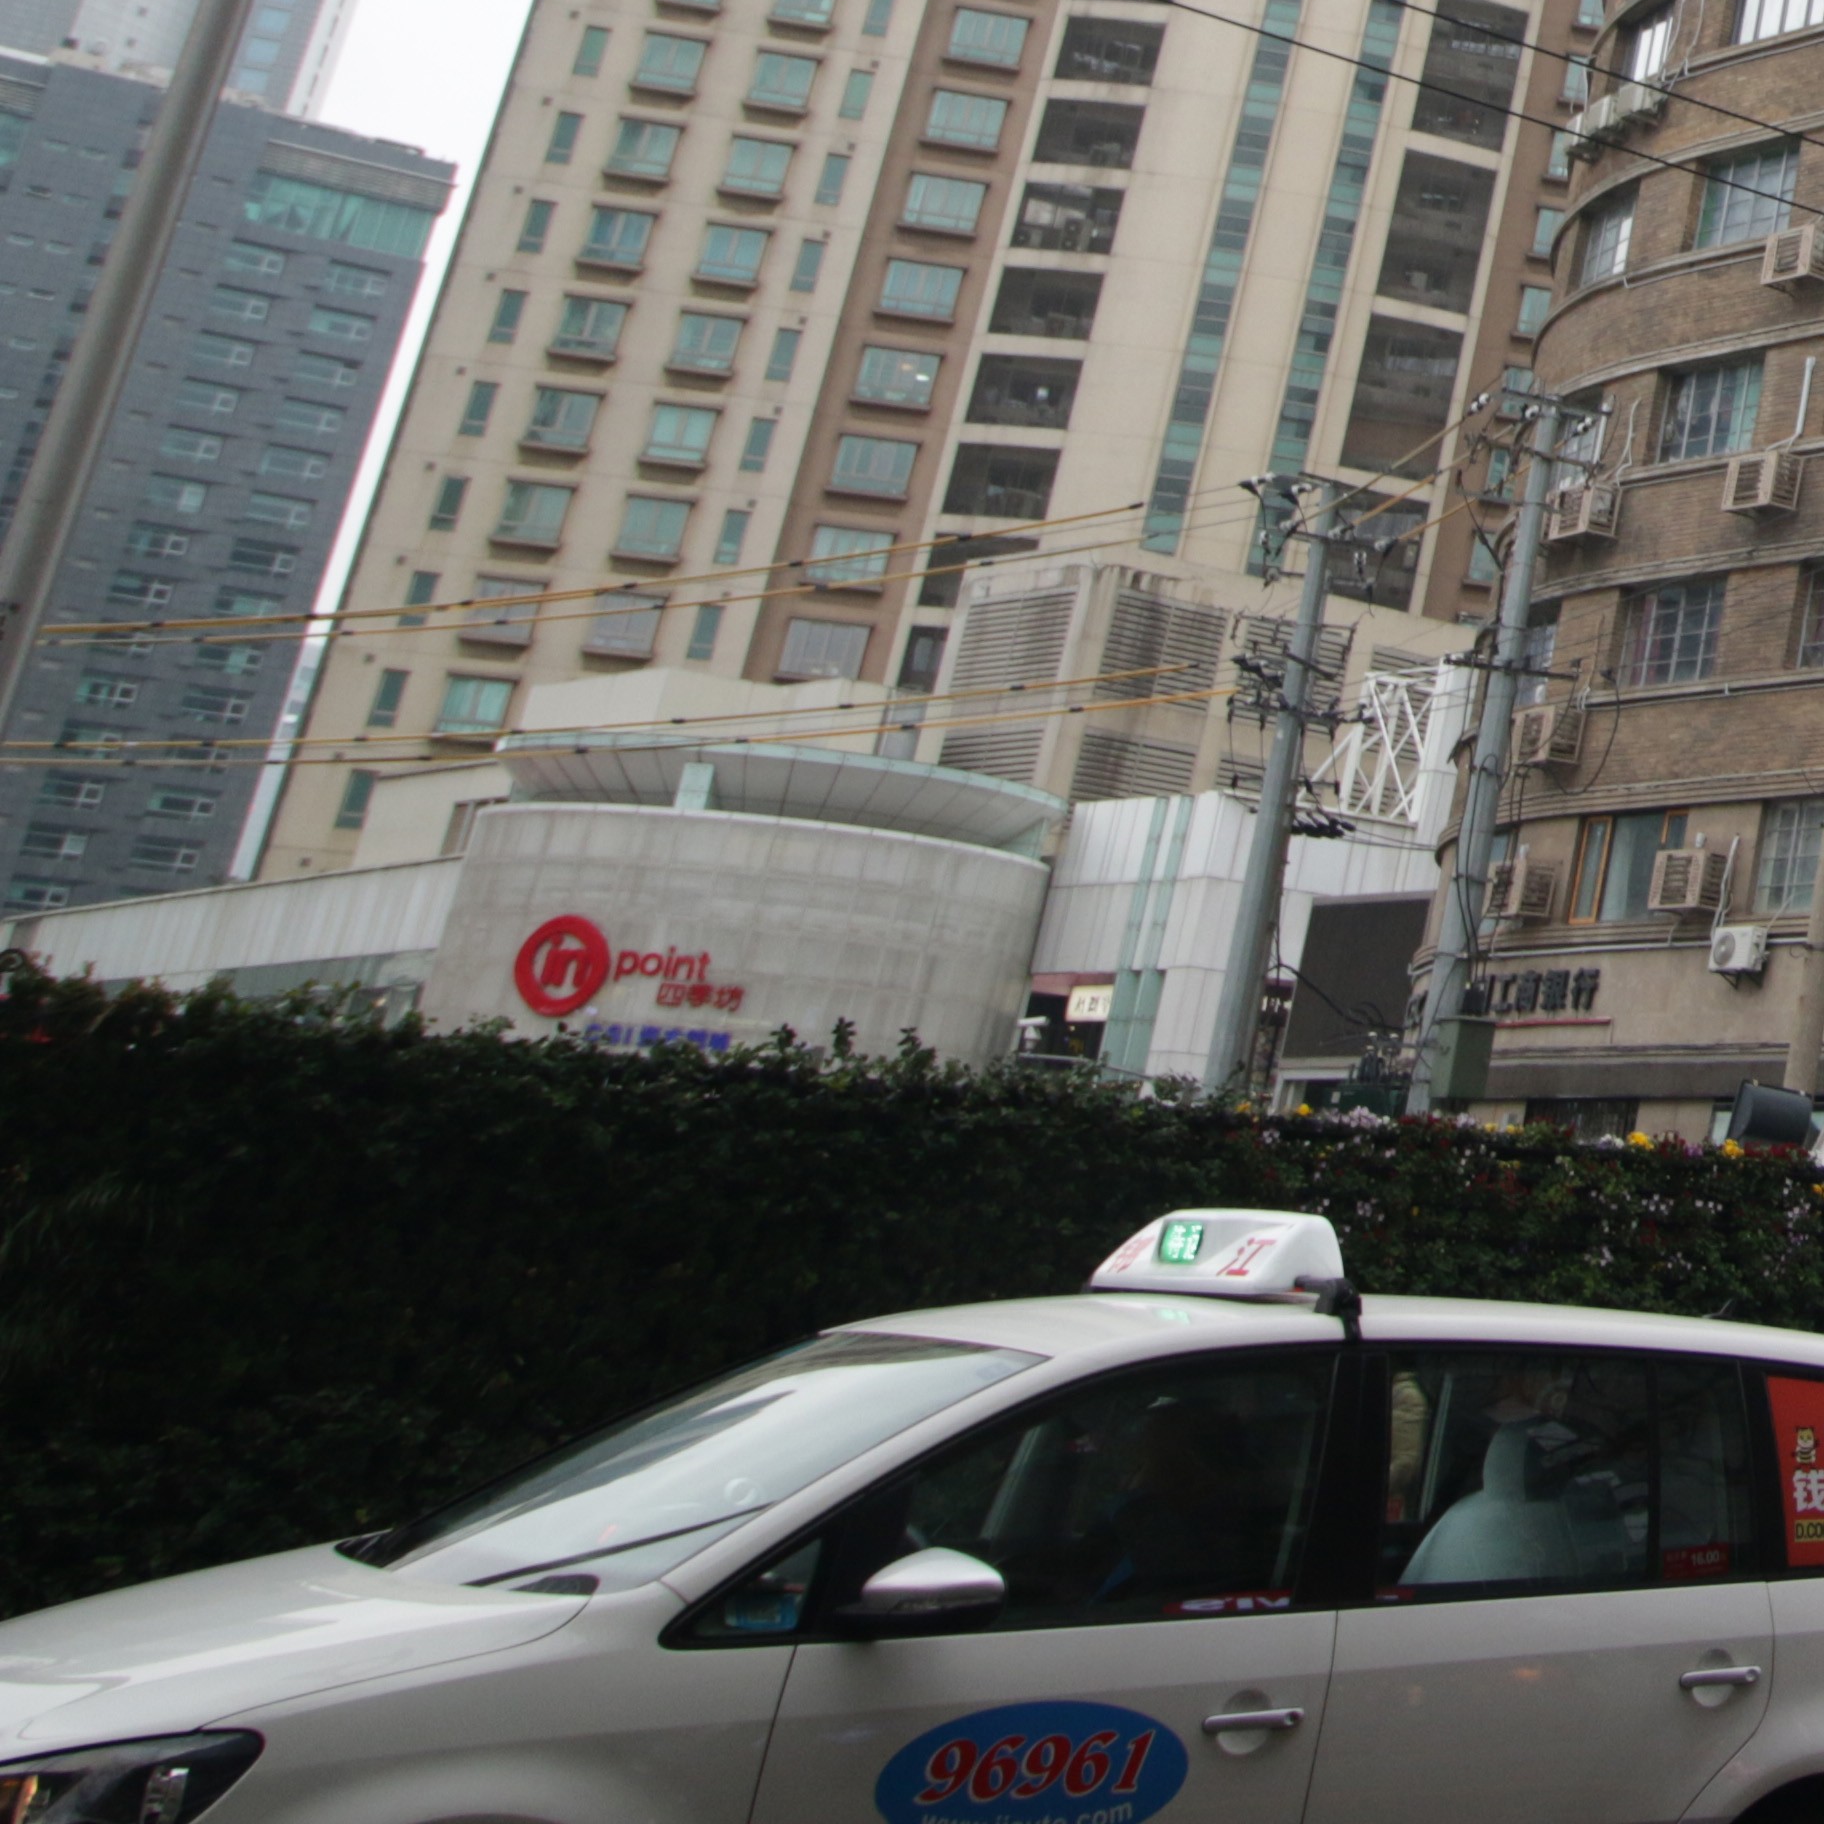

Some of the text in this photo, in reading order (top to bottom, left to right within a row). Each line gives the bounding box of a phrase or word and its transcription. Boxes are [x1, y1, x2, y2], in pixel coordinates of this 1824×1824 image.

[613, 946, 711, 982] point
[656, 981, 745, 1012] 四季坊
[1480, 968, 1600, 1015] 工商银行
[913, 1730, 1157, 1806] 96961
